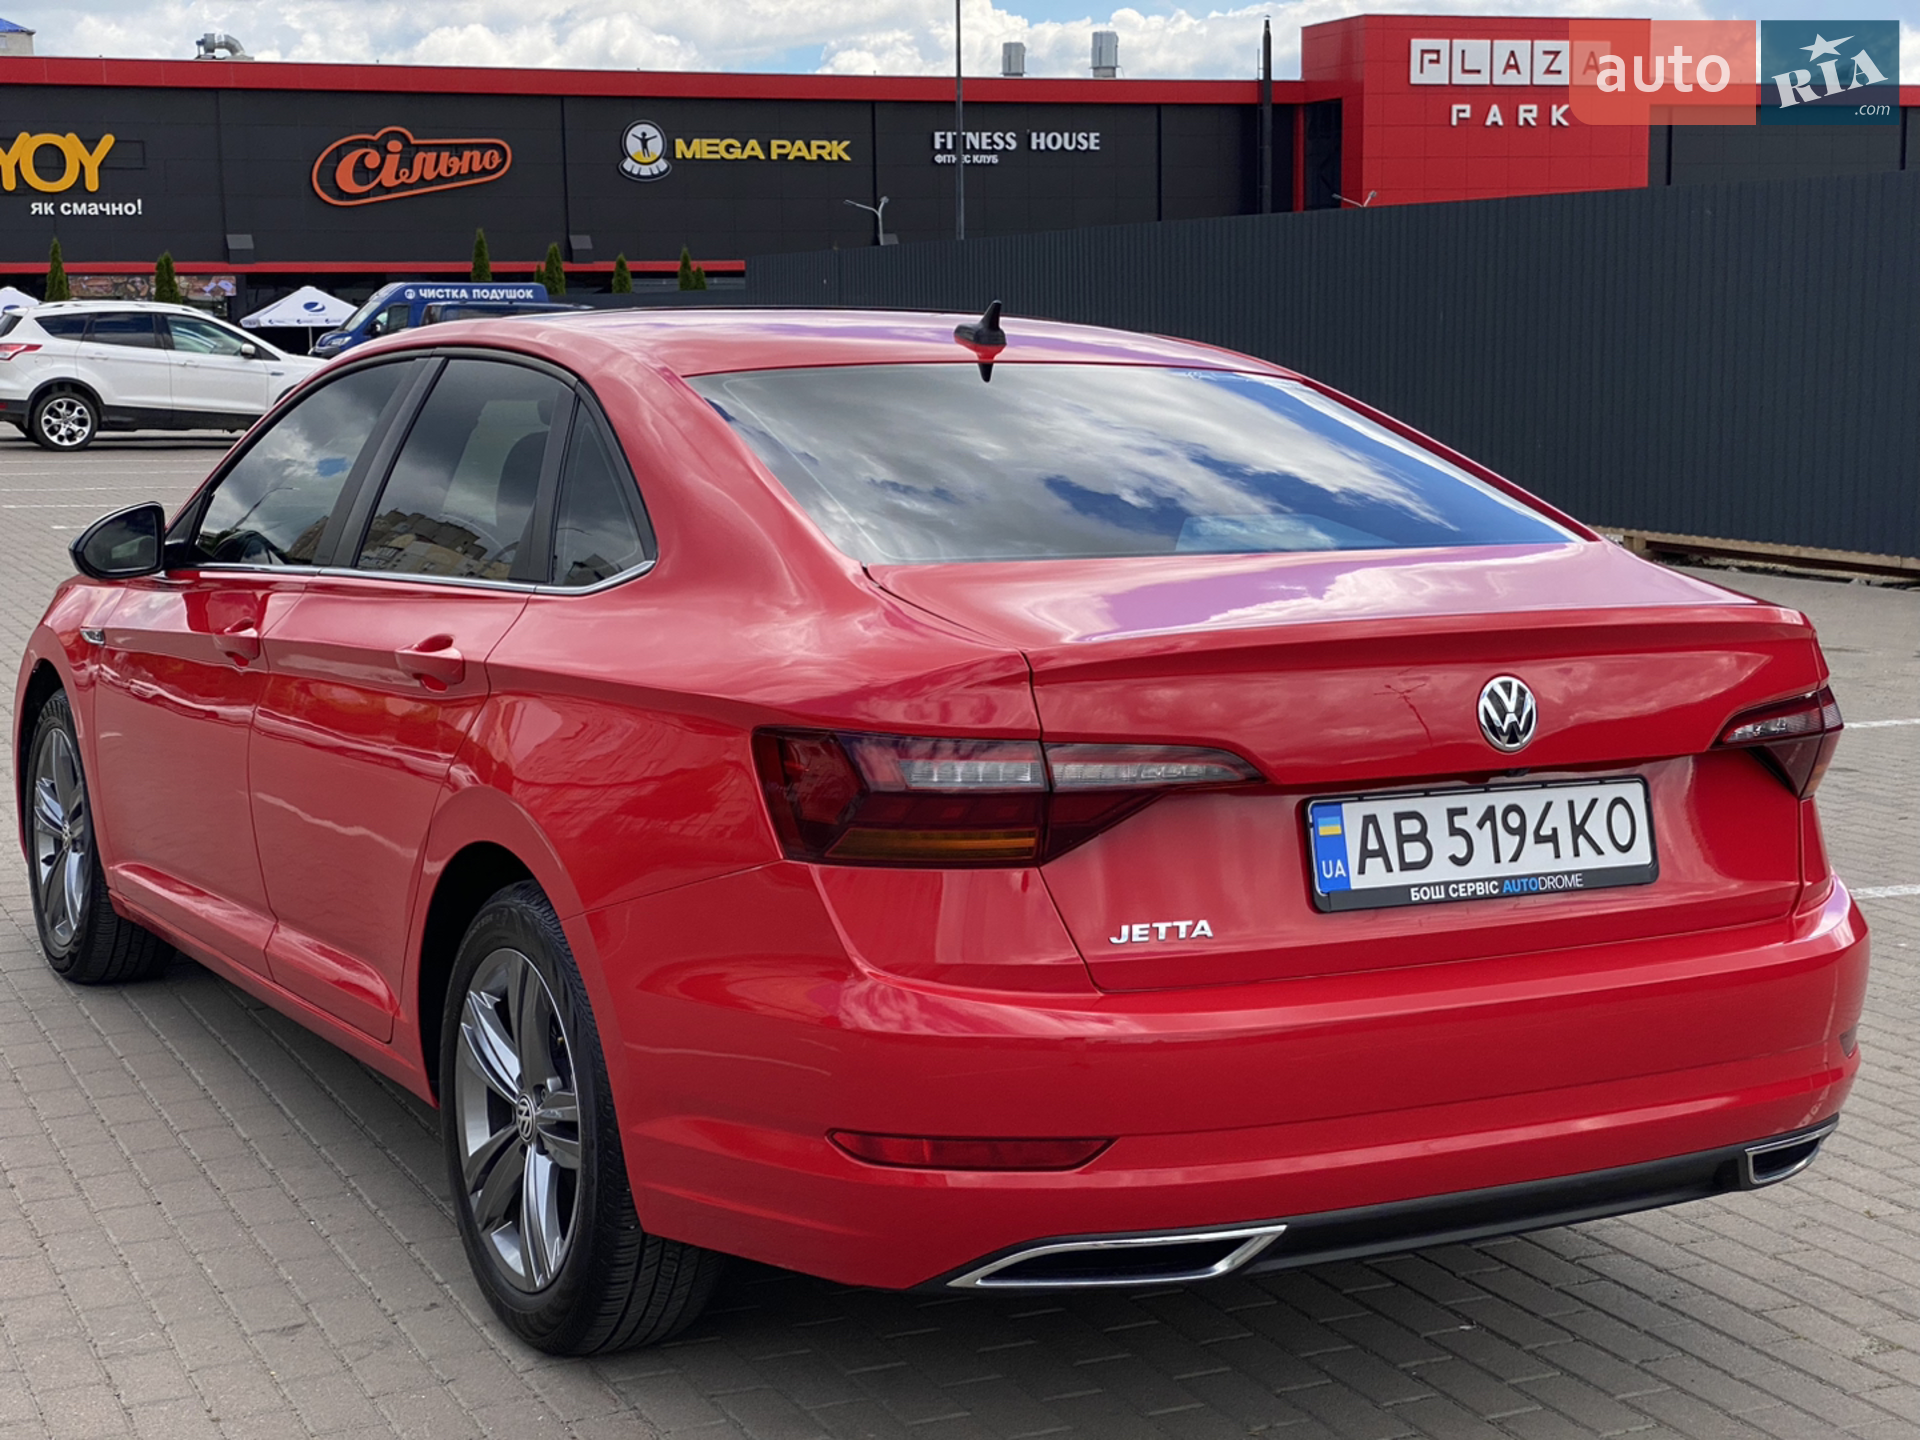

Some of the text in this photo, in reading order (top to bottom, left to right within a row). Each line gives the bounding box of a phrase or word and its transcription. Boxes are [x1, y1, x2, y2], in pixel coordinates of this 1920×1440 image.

[1418, 47, 1602, 78] PLAZA
[1451, 104, 1570, 127] PARK
[674, 138, 852, 162] MEGA PARK
[1030, 131, 1100, 151] HOUSE
[972, 153, 999, 165] КЛУБ
[30, 198, 143, 216] як смачно!
[418, 288, 534, 301] ЧИСТКА ПОДУШОК
[1357, 796, 1637, 876] AB 5194 KO
[1321, 859, 1347, 879] UA
[1410, 873, 1584, 901] БОШ СЕРВІС AUTODROME
[1109, 919, 1214, 944] JETTA
